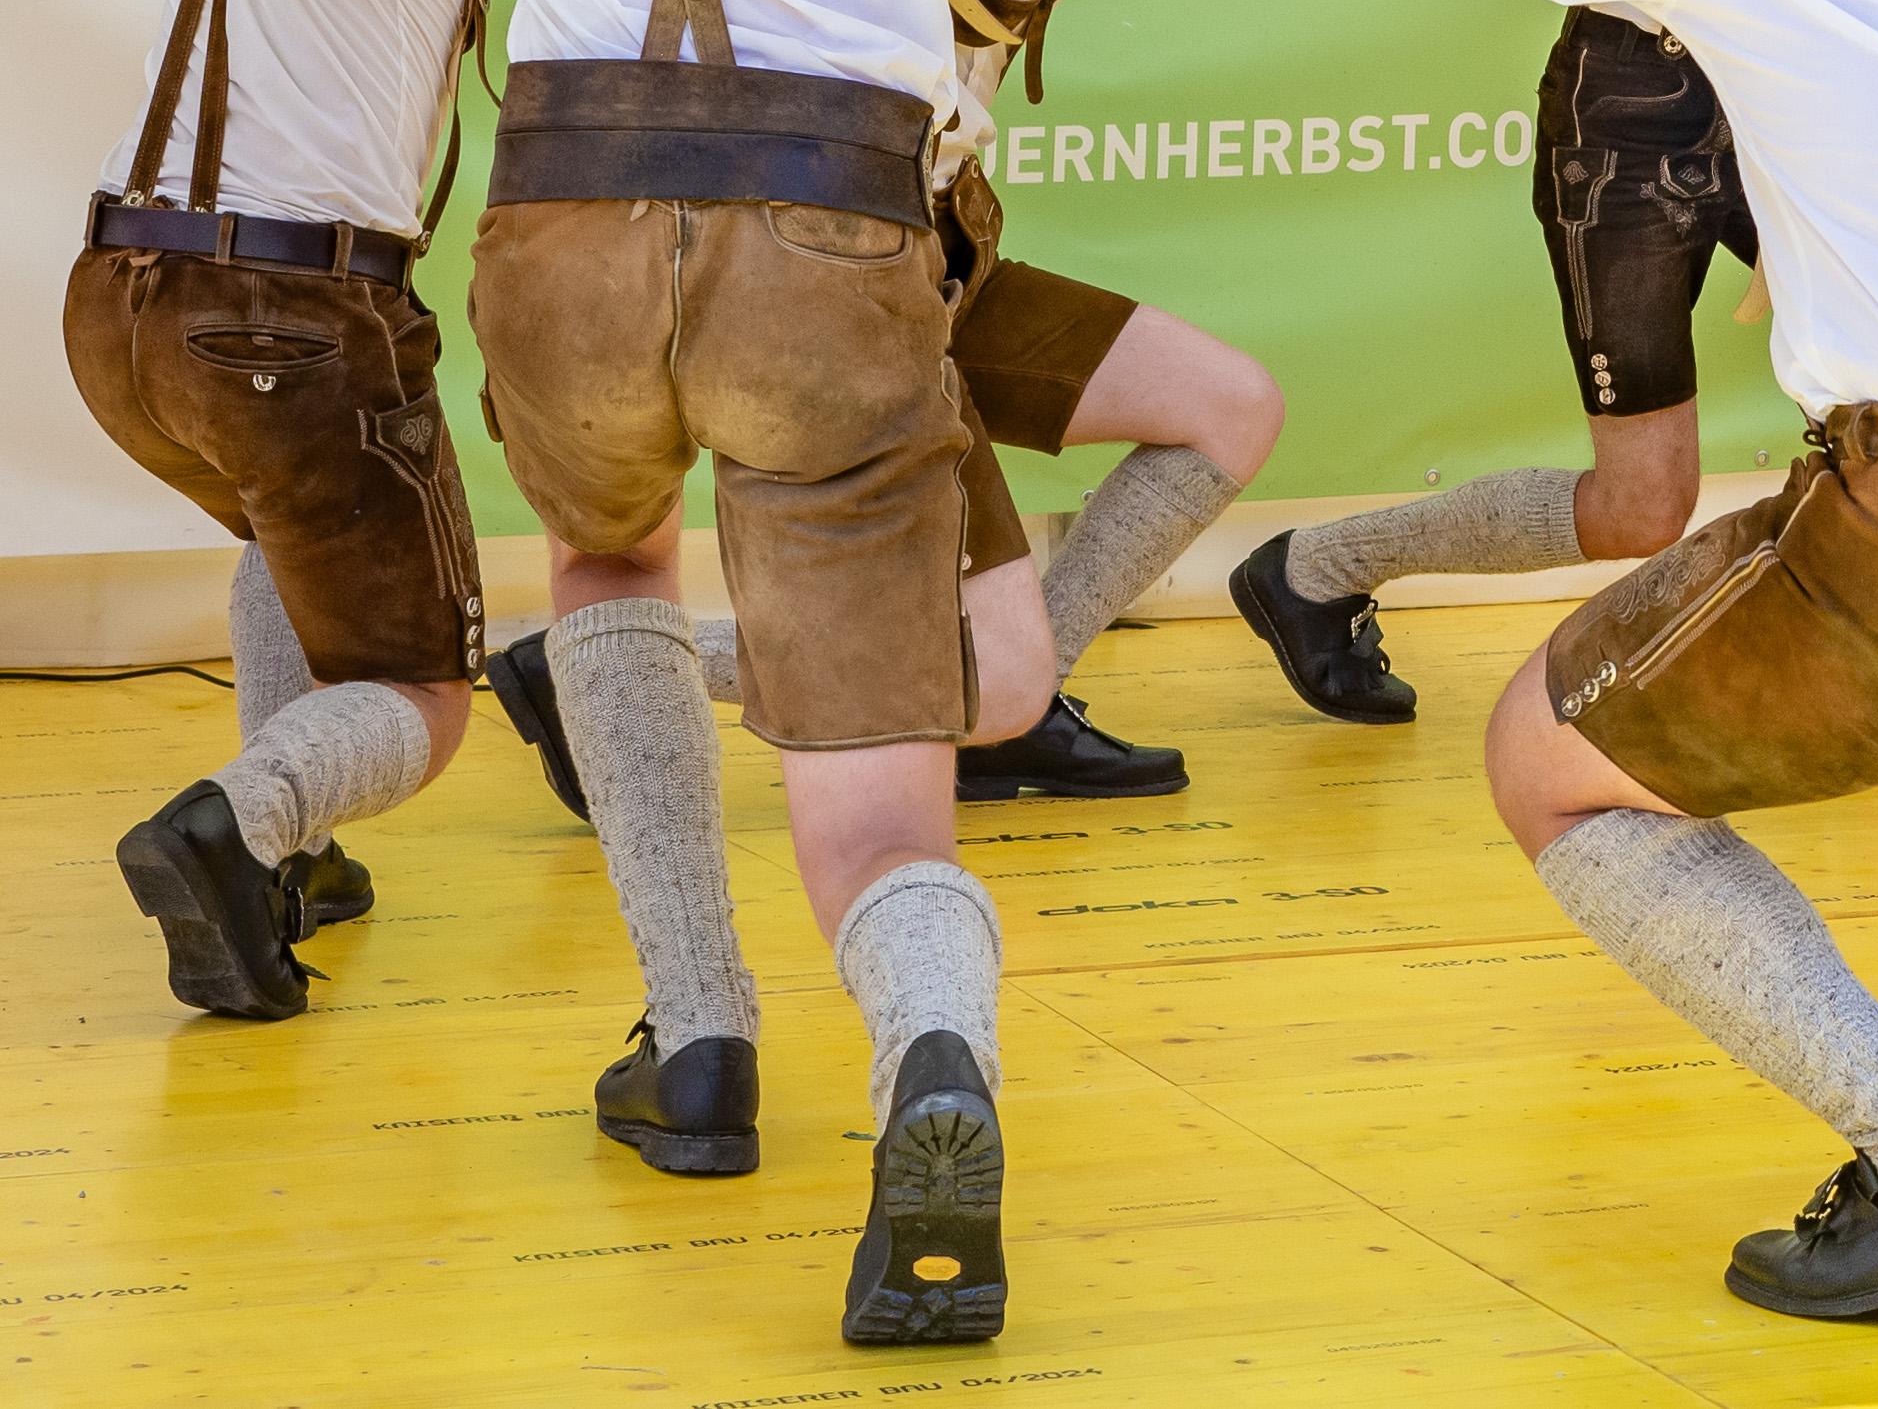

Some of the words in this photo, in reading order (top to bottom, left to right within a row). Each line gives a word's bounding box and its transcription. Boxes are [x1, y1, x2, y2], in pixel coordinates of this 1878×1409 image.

[978, 110, 1534, 184] ERNHERBST.CO
[956, 830, 1089, 845] oka
[1111, 820, 1234, 837] 3-SO
[1037, 897, 1240, 917] doka
[1262, 885, 1390, 902] 3-SO
[1144, 936, 1264, 950] KAISERER
[304, 1003, 379, 1014] ERER
[462, 989, 579, 1002] 04/2024
[1604, 1060, 1717, 1074] 04/2024
[371, 1114, 525, 1131] KAISERER
[535, 1108, 590, 1120] BAU
[512, 1242, 673, 1263] KAISERER
[688, 1236, 748, 1248] BAU
[44, 1284, 189, 1302] 04/2024
[690, 1390, 864, 1409] KAISERER
[878, 1381, 944, 1395] BAU
[960, 1367, 1104, 1388] 04/2024
